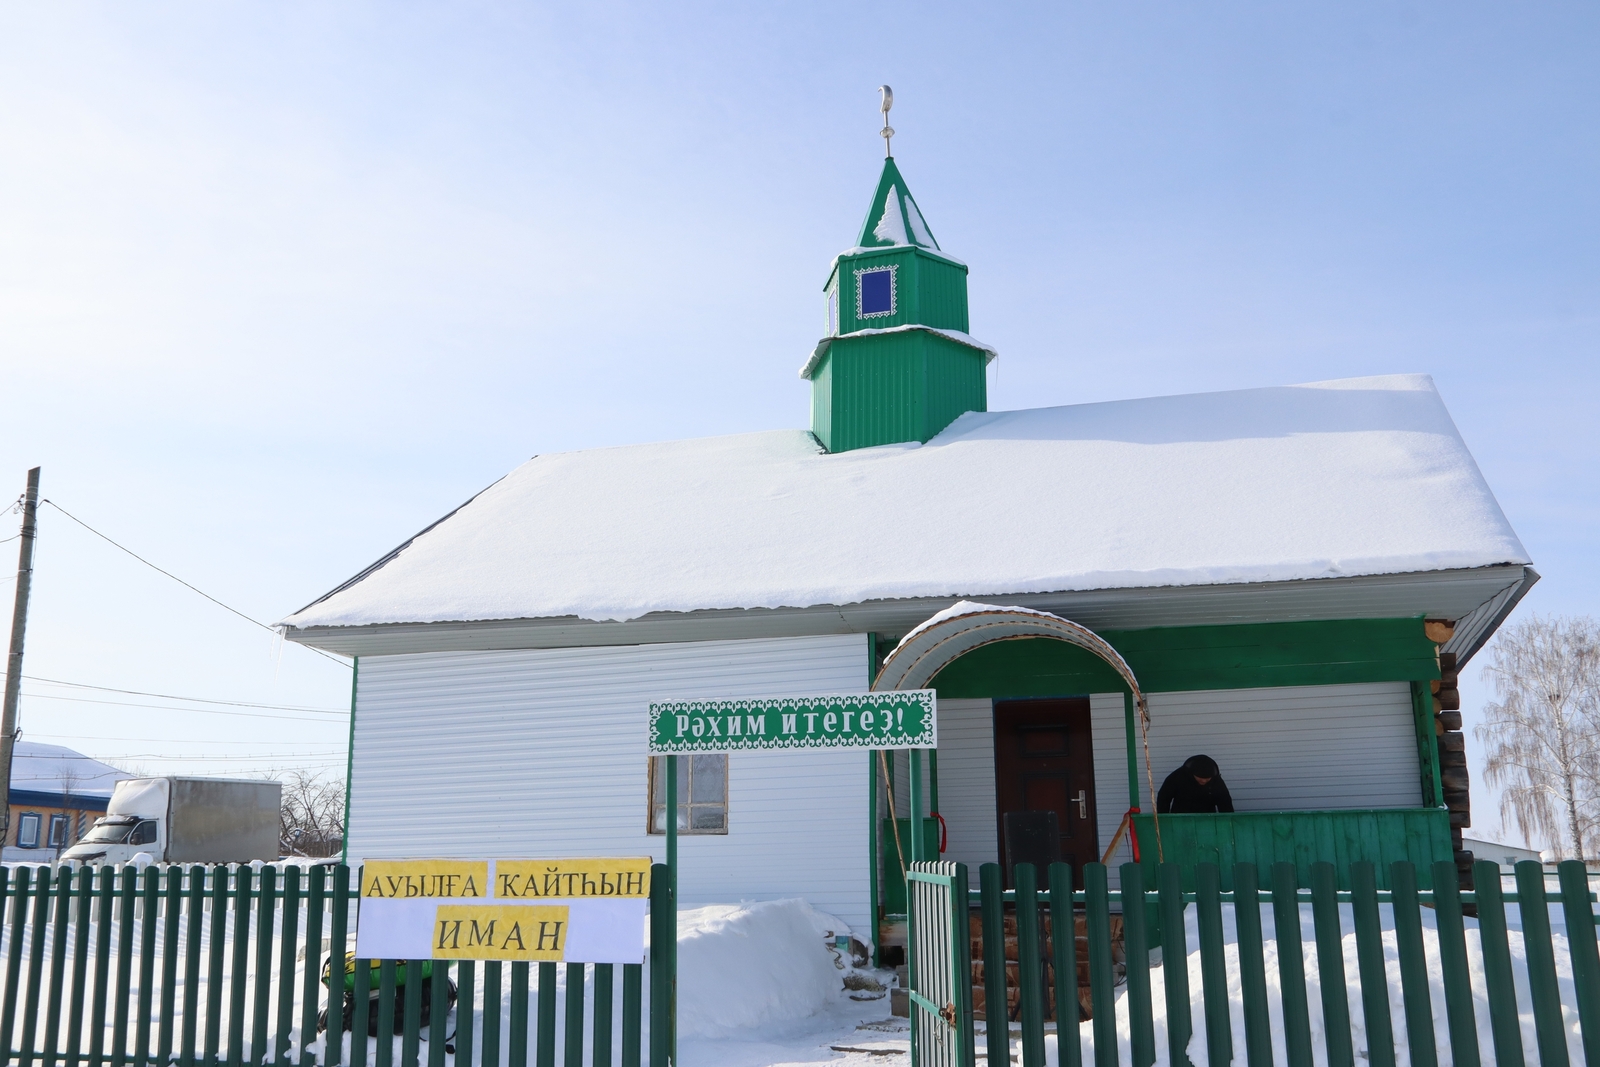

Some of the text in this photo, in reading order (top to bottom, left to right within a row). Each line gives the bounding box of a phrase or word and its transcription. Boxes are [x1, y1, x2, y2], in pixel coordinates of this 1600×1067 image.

[781, 707, 904, 734] итегеҙ!
[366, 874, 479, 898] АУЫЛҒА
[436, 919, 564, 951] ИМАН
